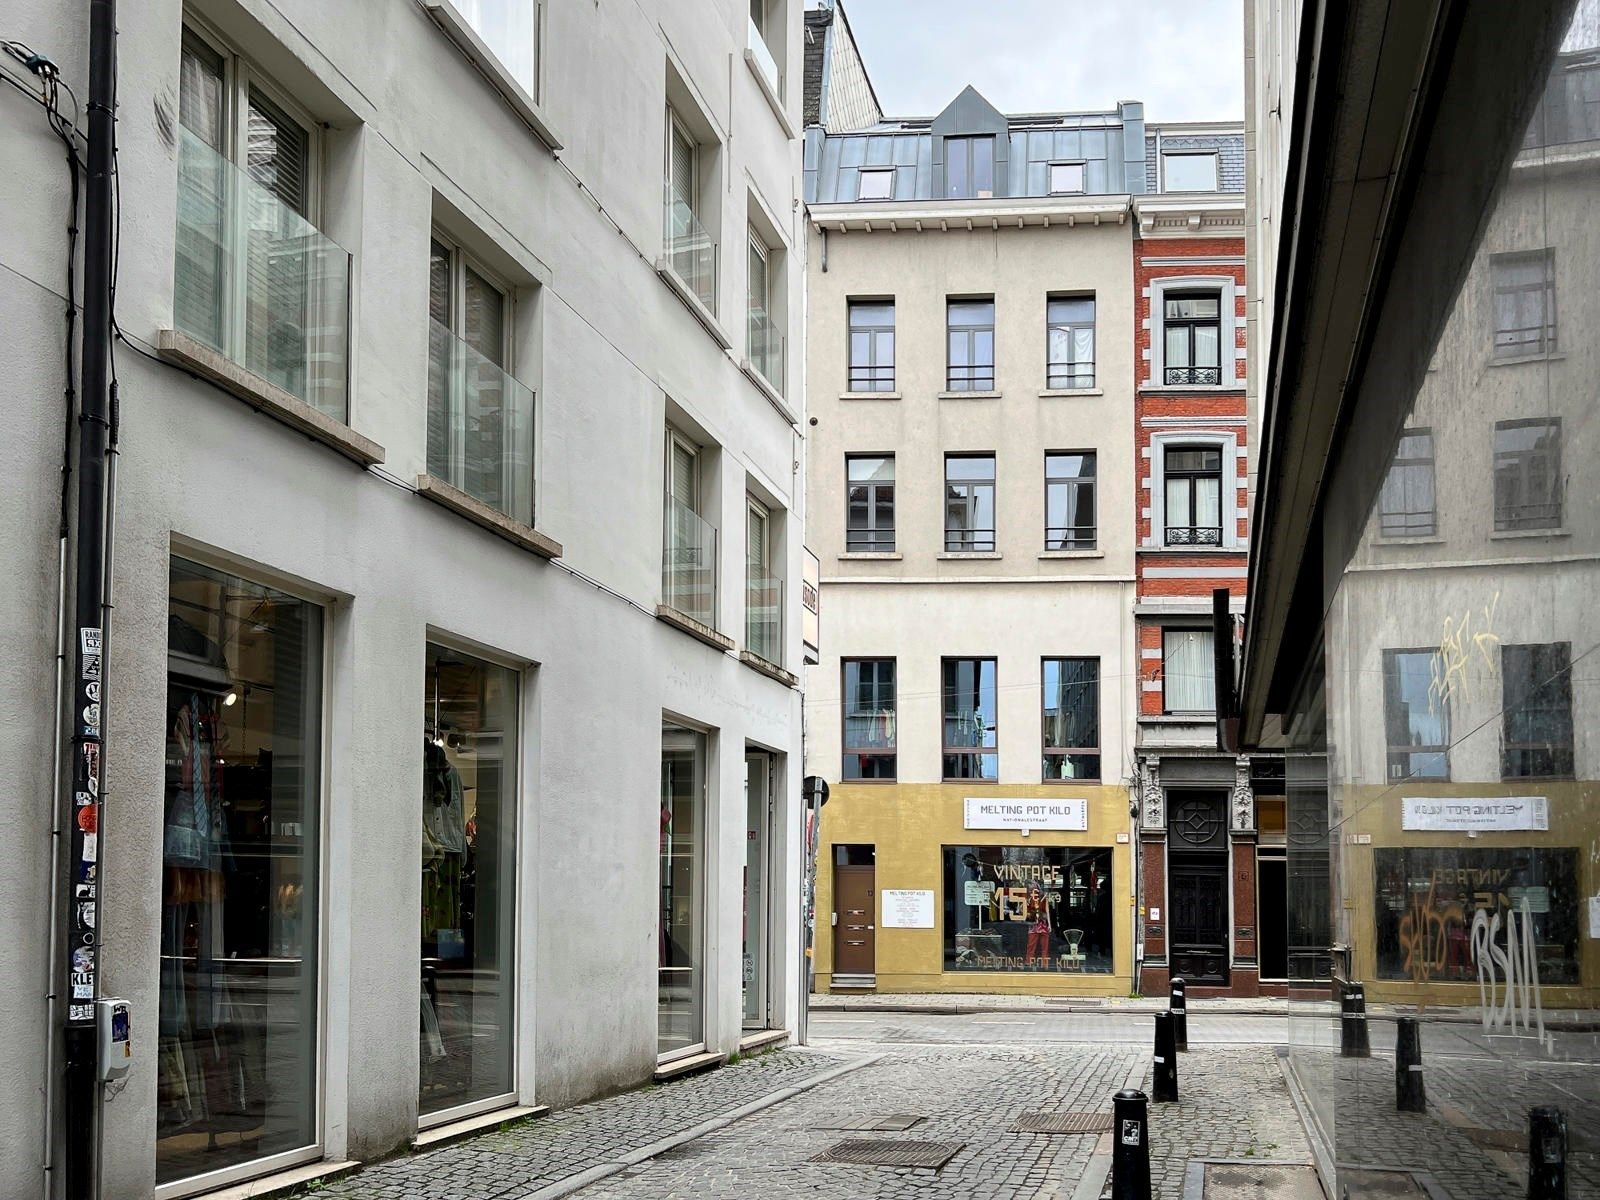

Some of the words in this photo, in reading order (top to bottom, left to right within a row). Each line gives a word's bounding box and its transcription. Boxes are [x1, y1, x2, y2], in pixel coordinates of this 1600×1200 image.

[980, 804, 1023, 815] MELTING
[1026, 805, 1047, 815] POT
[1049, 806, 1071, 816] KILO
[993, 864, 1061, 881] VINTAGE
[994, 886, 1028, 921] 15
[977, 955, 1024, 968] MELTING
[1029, 957, 1051, 969] POT
[1056, 957, 1080, 969] KILO
